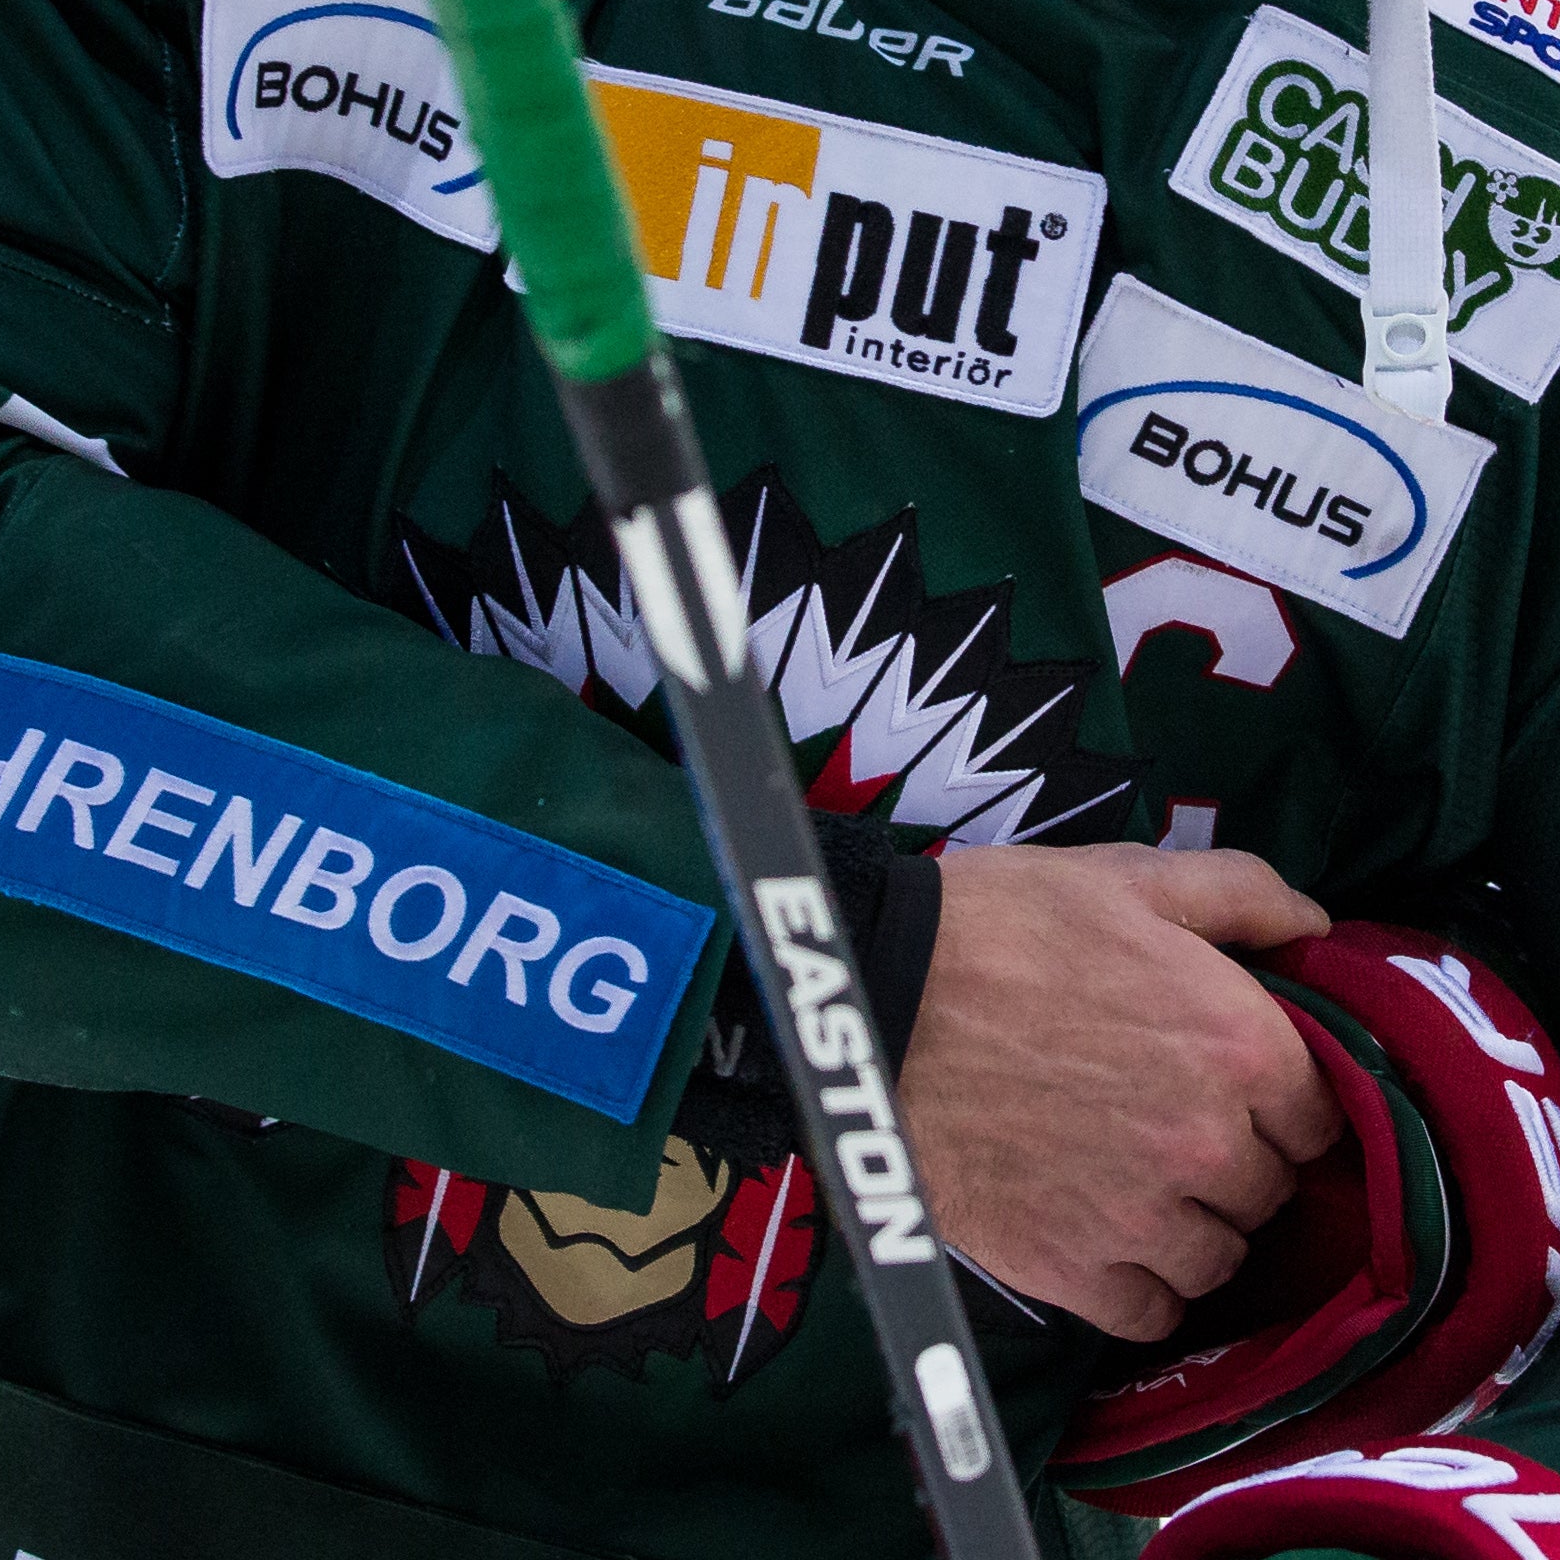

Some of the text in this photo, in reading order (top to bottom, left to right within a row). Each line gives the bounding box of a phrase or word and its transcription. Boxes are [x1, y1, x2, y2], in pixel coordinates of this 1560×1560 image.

[255, 61, 461, 163] BOHUS
[658, 138, 1040, 351] input
[844, 326, 1013, 390] interiör
[1129, 411, 1372, 549] BOHUS
[753, 875, 937, 1266] EASTON
